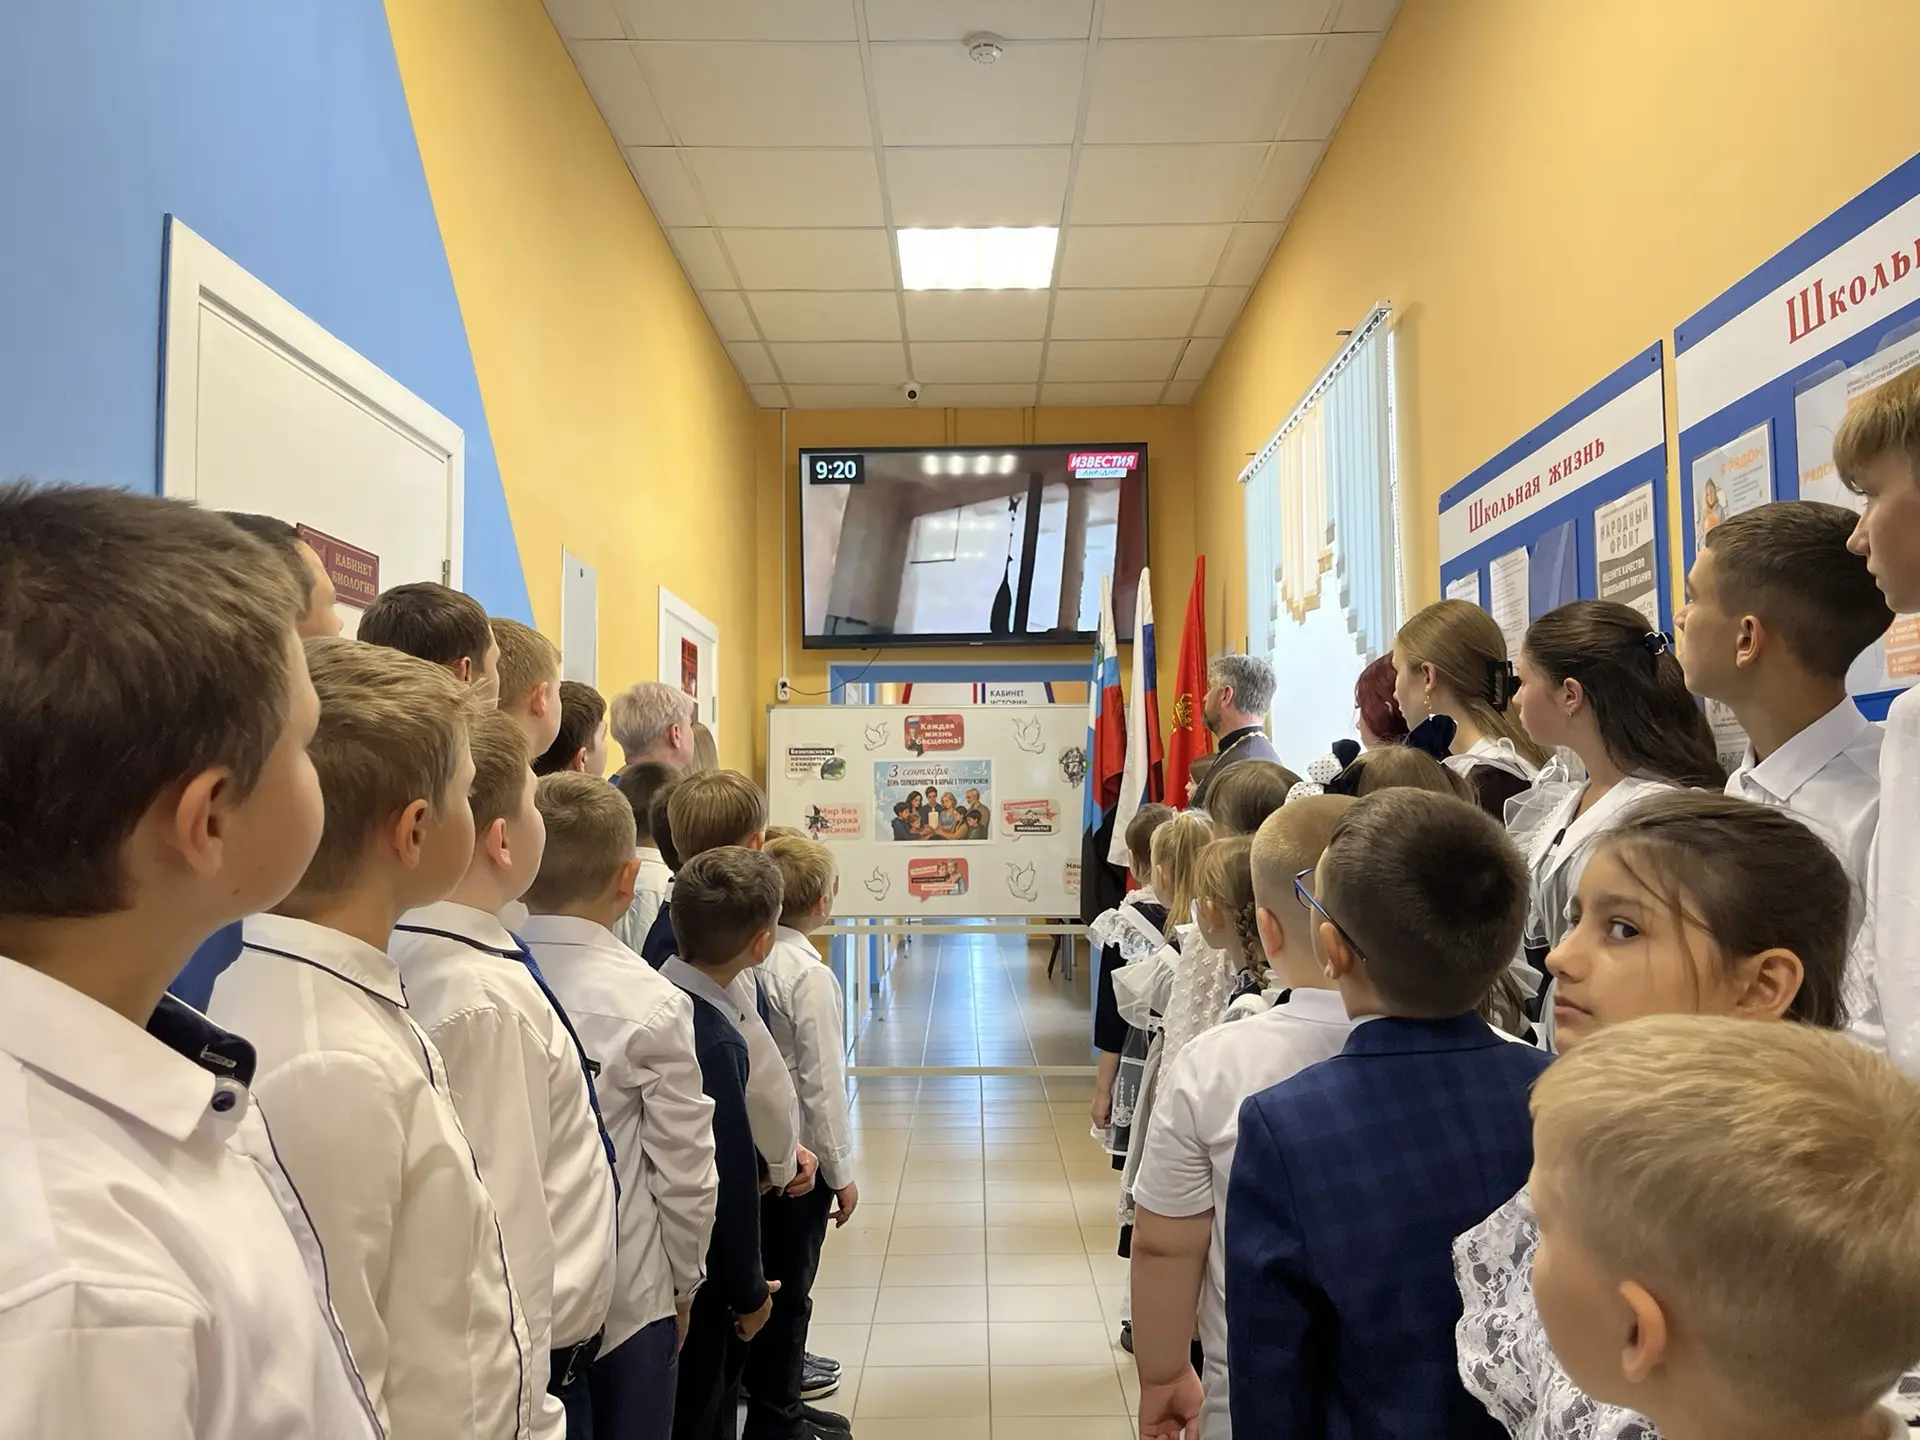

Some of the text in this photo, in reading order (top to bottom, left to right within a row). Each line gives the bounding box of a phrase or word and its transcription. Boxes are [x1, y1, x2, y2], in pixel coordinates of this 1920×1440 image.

[815, 460, 857, 480] 9:20
[1070, 455, 1135, 468] ИЗВЕСТИЯ
[1468, 474, 1541, 533] Школьная
[1548, 437, 1605, 486] жизнь
[1600, 502, 1648, 542] НАРОДНЫЙ
[1610, 528, 1639, 554] ФРОНТ
[335, 553, 373, 577] КАБИНЕТ
[332, 570, 376, 596] БИОЛОГИИ
[920, 723, 955, 731] Каждая
[915, 736, 962, 746] бесценна!
[889, 764, 949, 779] 3 сентября
[819, 806, 858, 816] Мир без
